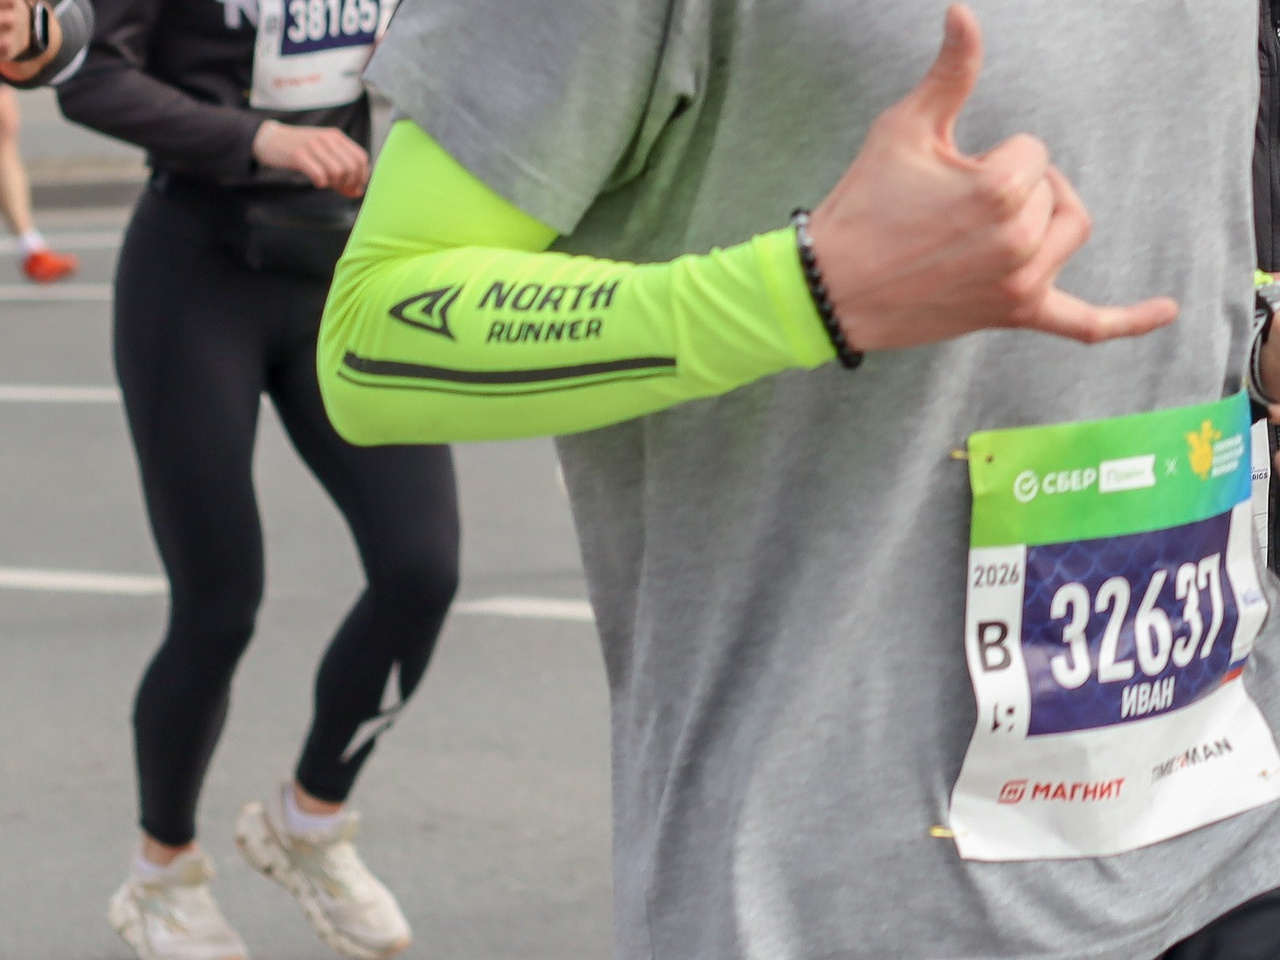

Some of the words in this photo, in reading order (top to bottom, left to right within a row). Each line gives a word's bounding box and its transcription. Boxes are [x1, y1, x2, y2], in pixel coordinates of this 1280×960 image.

[476, 279, 623, 312] NORTH
[485, 318, 604, 344] RUNNER
[1041, 466, 1098, 496] СБЕР
[972, 562, 1021, 589] 2026
[1049, 551, 1226, 691] 32637
[1120, 675, 1175, 720] ИВАН
[1031, 776, 1126, 802] МАГНИТ
